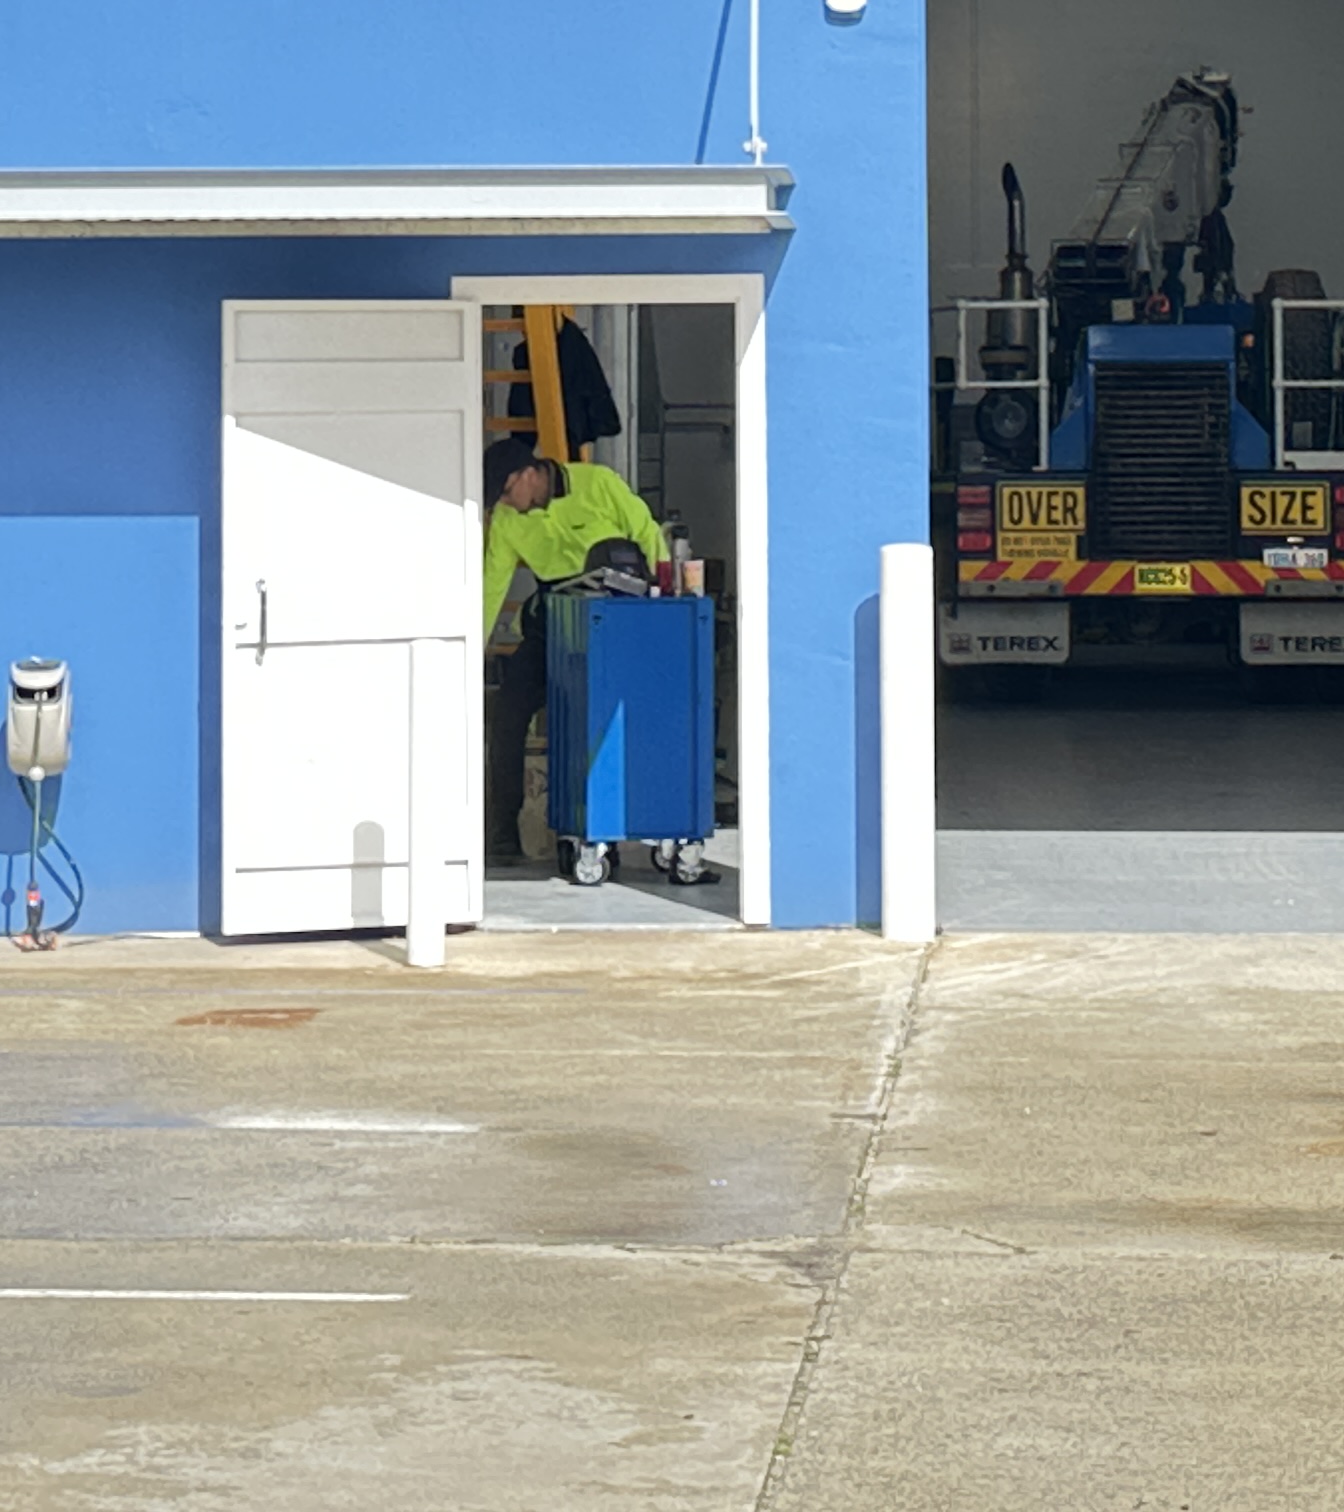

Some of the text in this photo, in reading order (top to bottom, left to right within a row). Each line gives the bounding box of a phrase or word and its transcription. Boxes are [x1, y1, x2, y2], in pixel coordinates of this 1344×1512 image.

[1008, 490, 1317, 525] OVER SIZE
[977, 636, 1060, 651] TEREX
